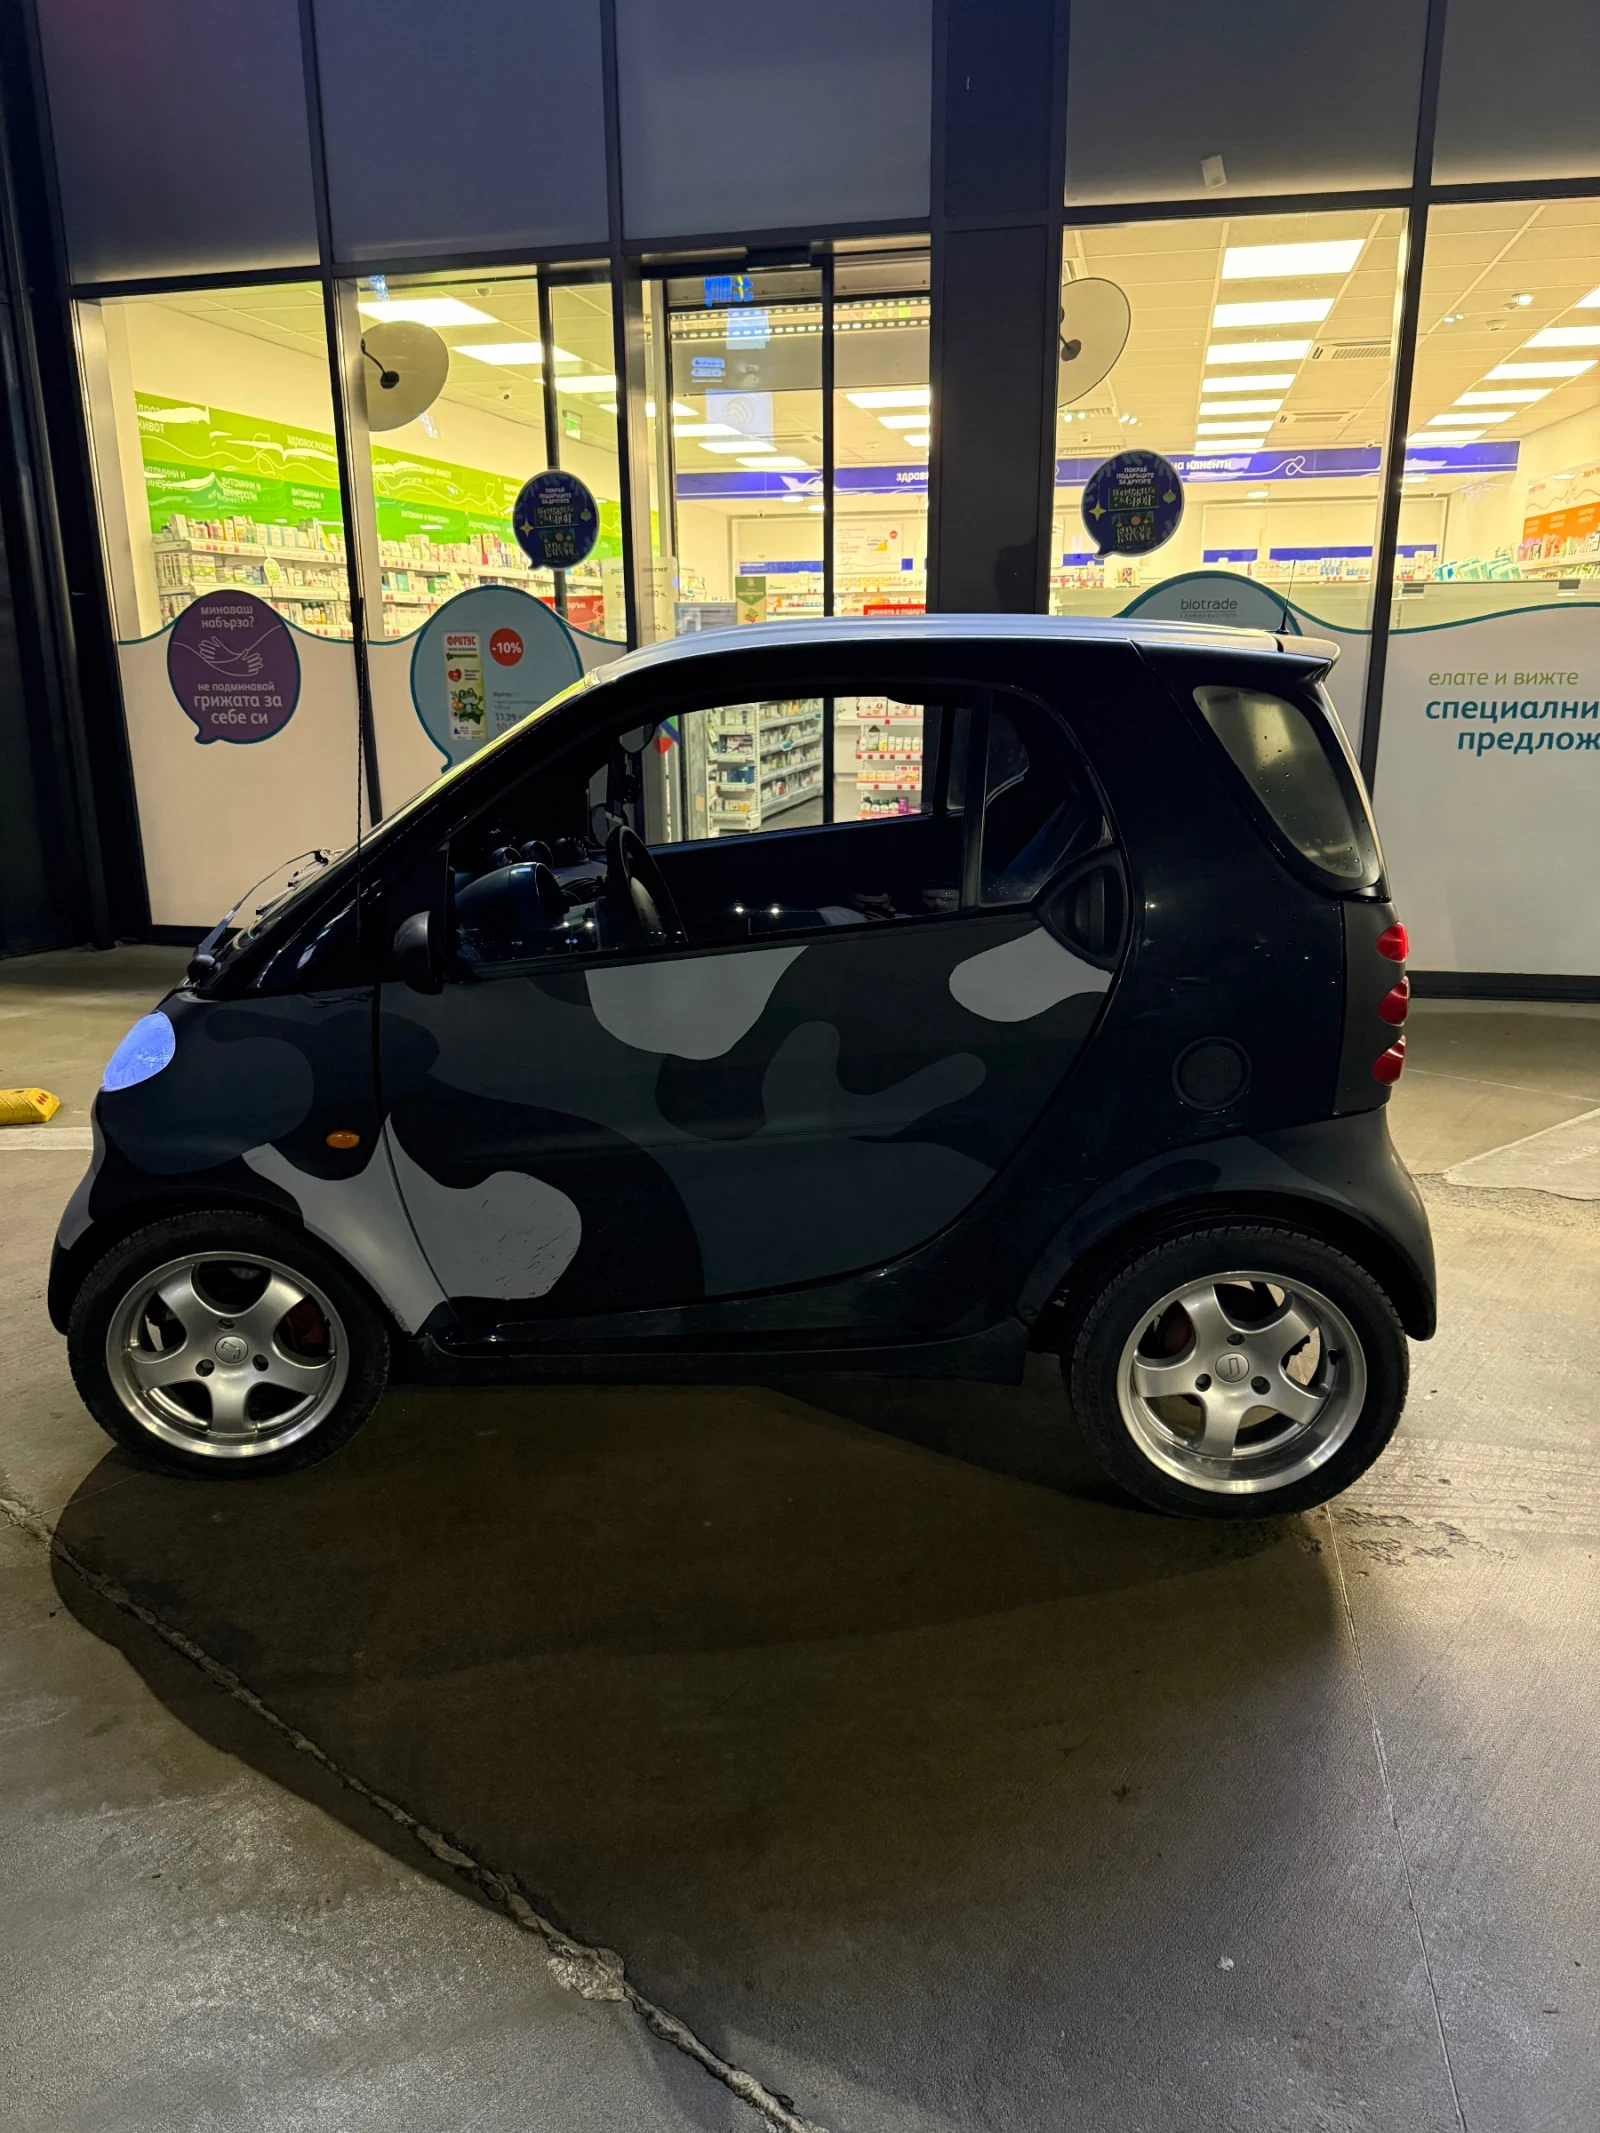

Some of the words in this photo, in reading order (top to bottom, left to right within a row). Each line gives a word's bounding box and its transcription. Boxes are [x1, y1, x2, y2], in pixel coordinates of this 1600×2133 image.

[200, 606, 253, 615] минаваш
[1181, 598, 1238, 610] biotrade
[201, 616, 255, 631] набързо?
[446, 636, 476, 646] ФРИТУС
[491, 642, 522, 654] -10%
[1428, 672, 1489, 686] елате
[1494, 672, 1507, 686] и
[1513, 671, 1579, 686] вижте
[197, 683, 210, 691] не
[212, 681, 275, 692] подминавай
[193, 695, 260, 711] грижата
[264, 695, 283, 707] за
[210, 709, 247, 724] себе
[250, 713, 268, 724] си
[1425, 700, 1600, 724] специални
[1457, 732, 1600, 757] предлож
